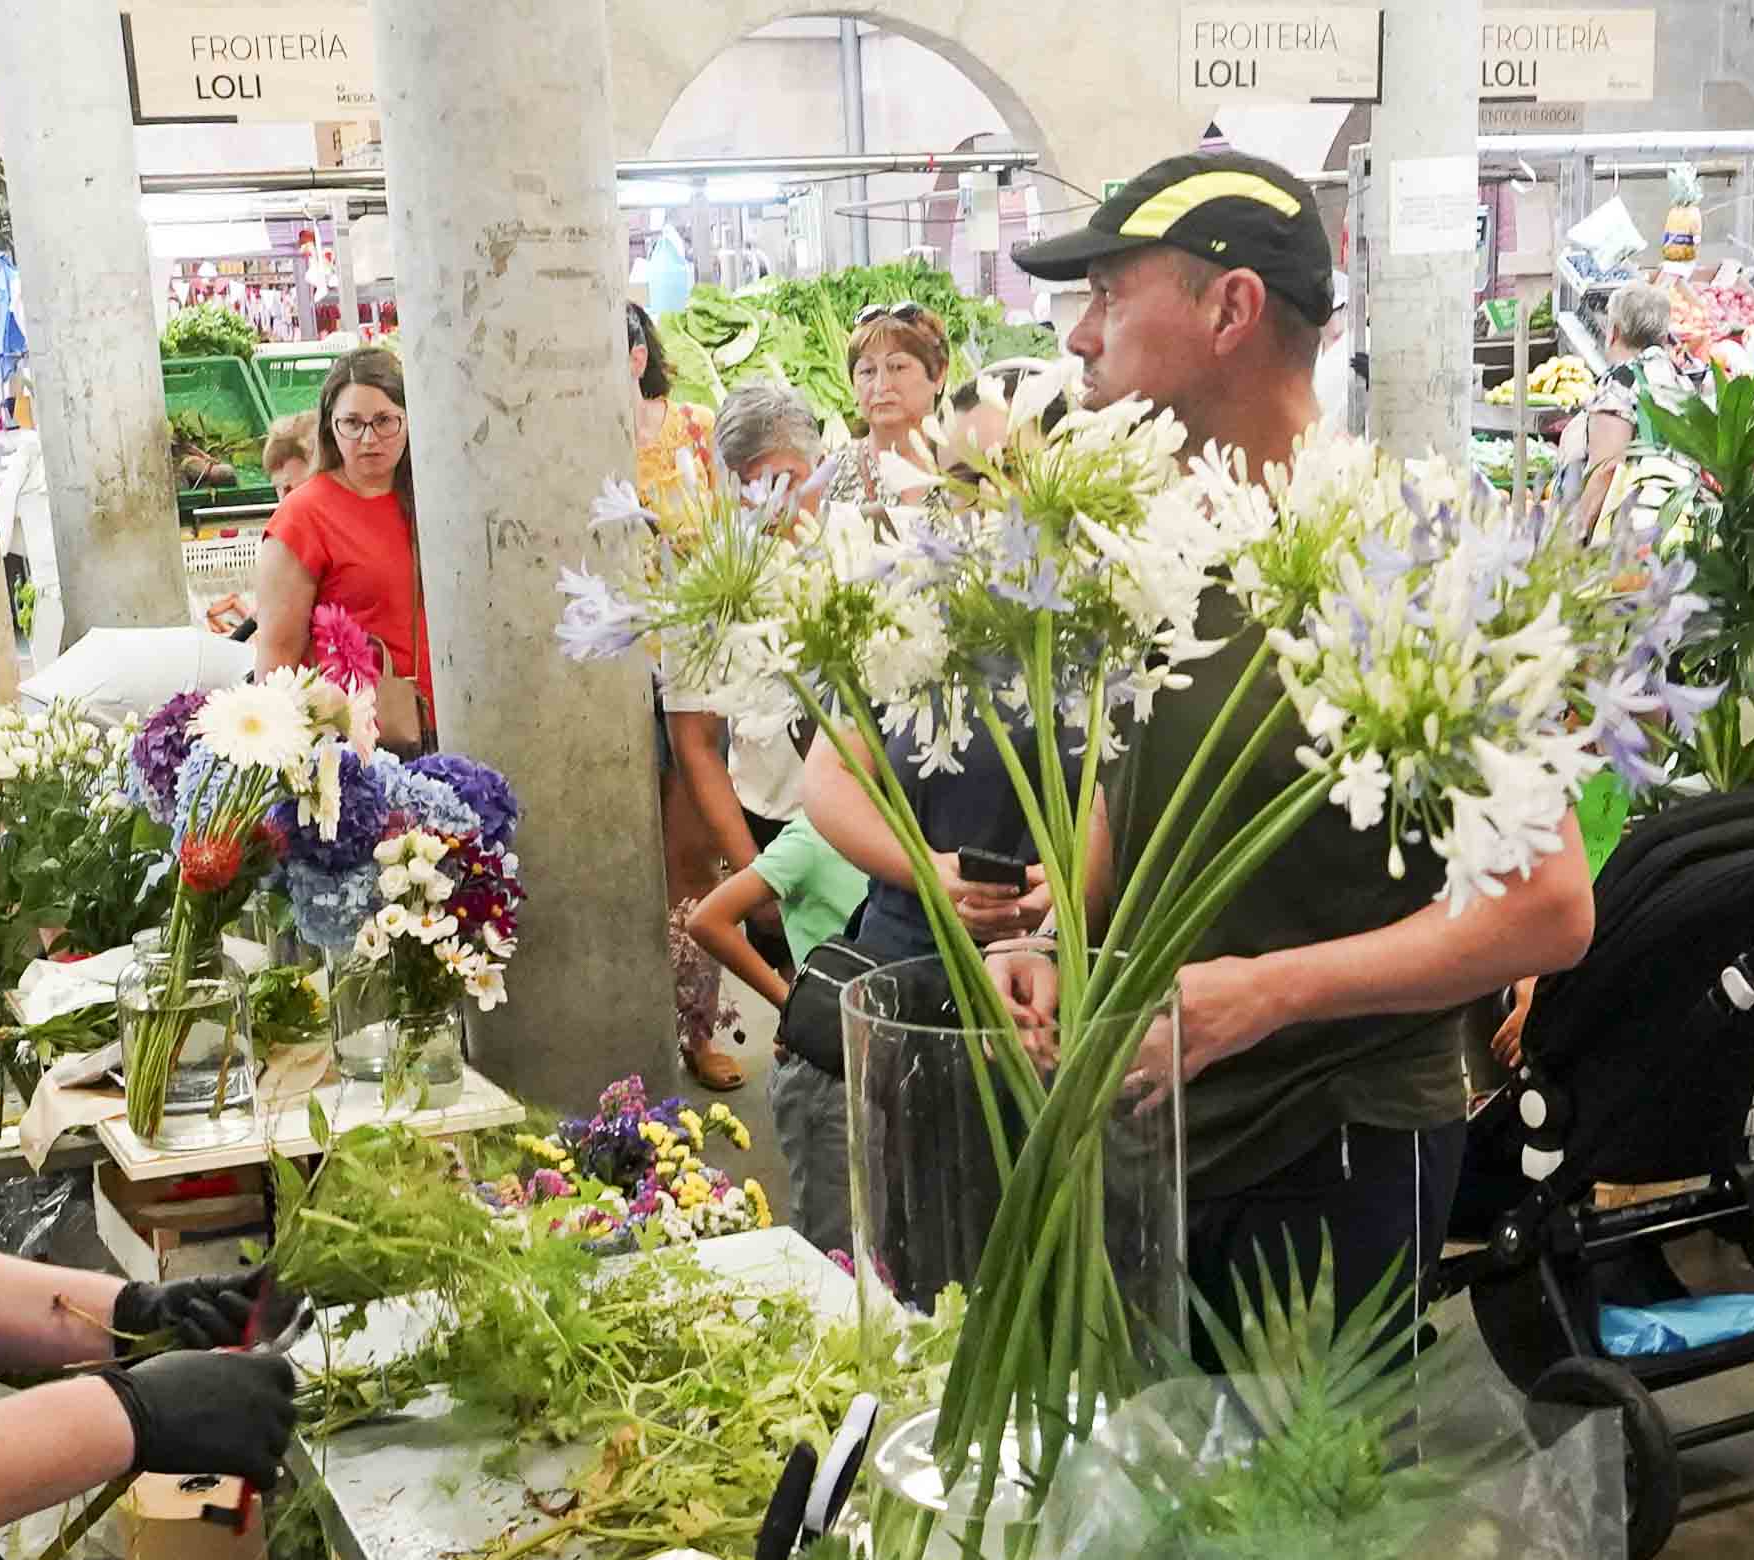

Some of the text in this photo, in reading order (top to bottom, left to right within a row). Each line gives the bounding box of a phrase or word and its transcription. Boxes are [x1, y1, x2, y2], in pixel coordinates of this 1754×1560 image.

[191, 27, 348, 61] FROITERÍA
[1194, 16, 1339, 50] FROITERÍA
[1482, 17, 1611, 51] FROITERÍA
[196, 74, 262, 99] LOLI
[1194, 59, 1256, 87] LOLI
[1482, 60, 1537, 87] LOLI
[337, 94, 376, 104] MERCA
